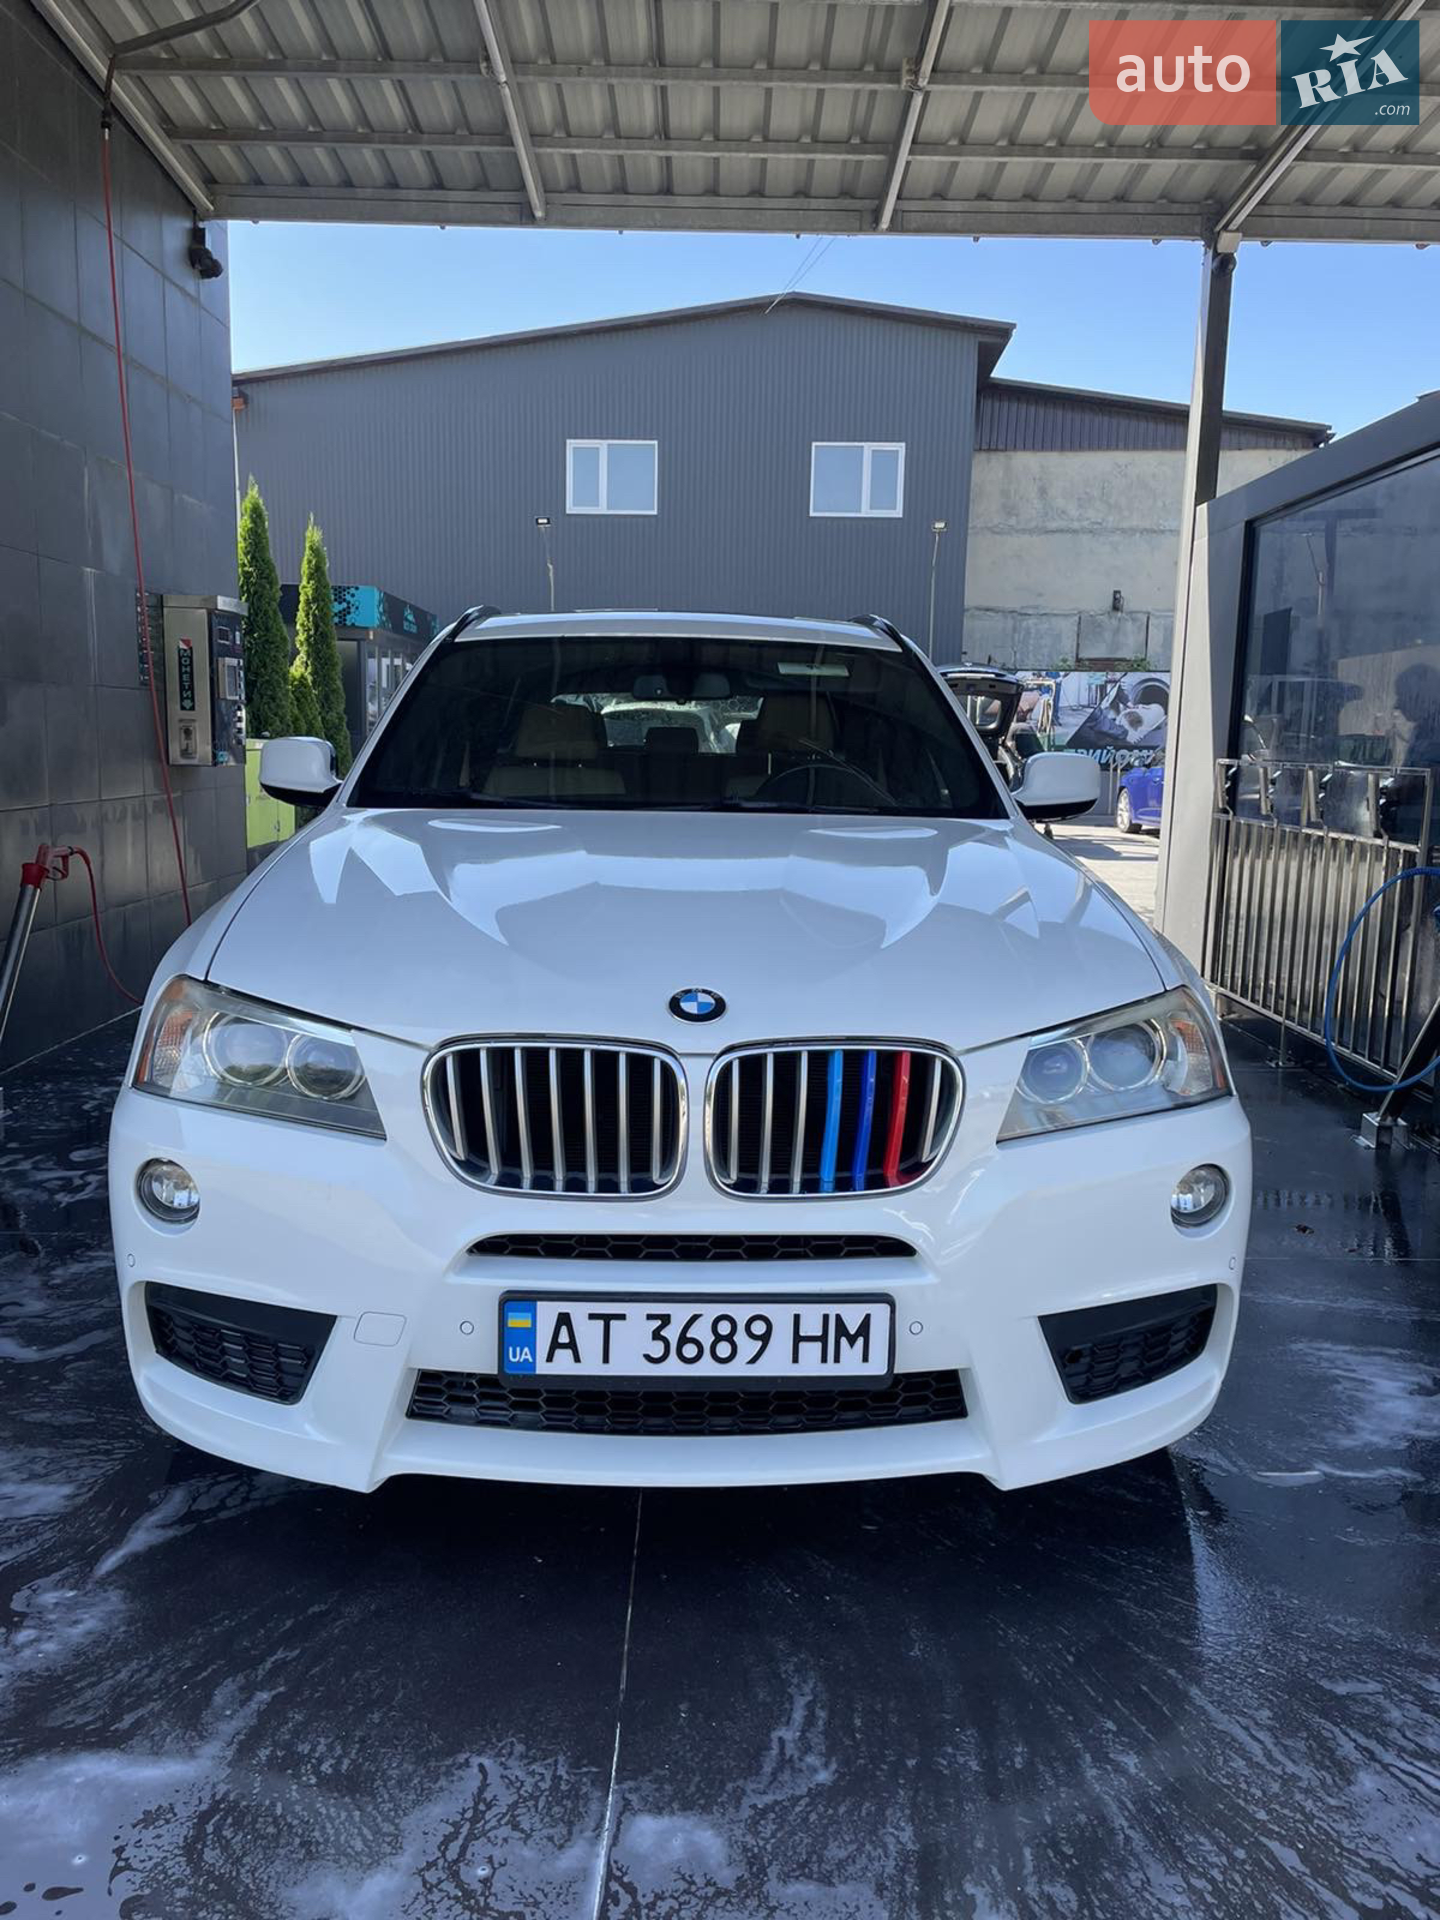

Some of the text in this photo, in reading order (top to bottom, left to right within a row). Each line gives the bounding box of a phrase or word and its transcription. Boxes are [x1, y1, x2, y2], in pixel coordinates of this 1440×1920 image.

[180, 649, 193, 699] МОНЕТИ
[508, 1347, 533, 1363] UA
[545, 1311, 872, 1365] AT 3689 HM
